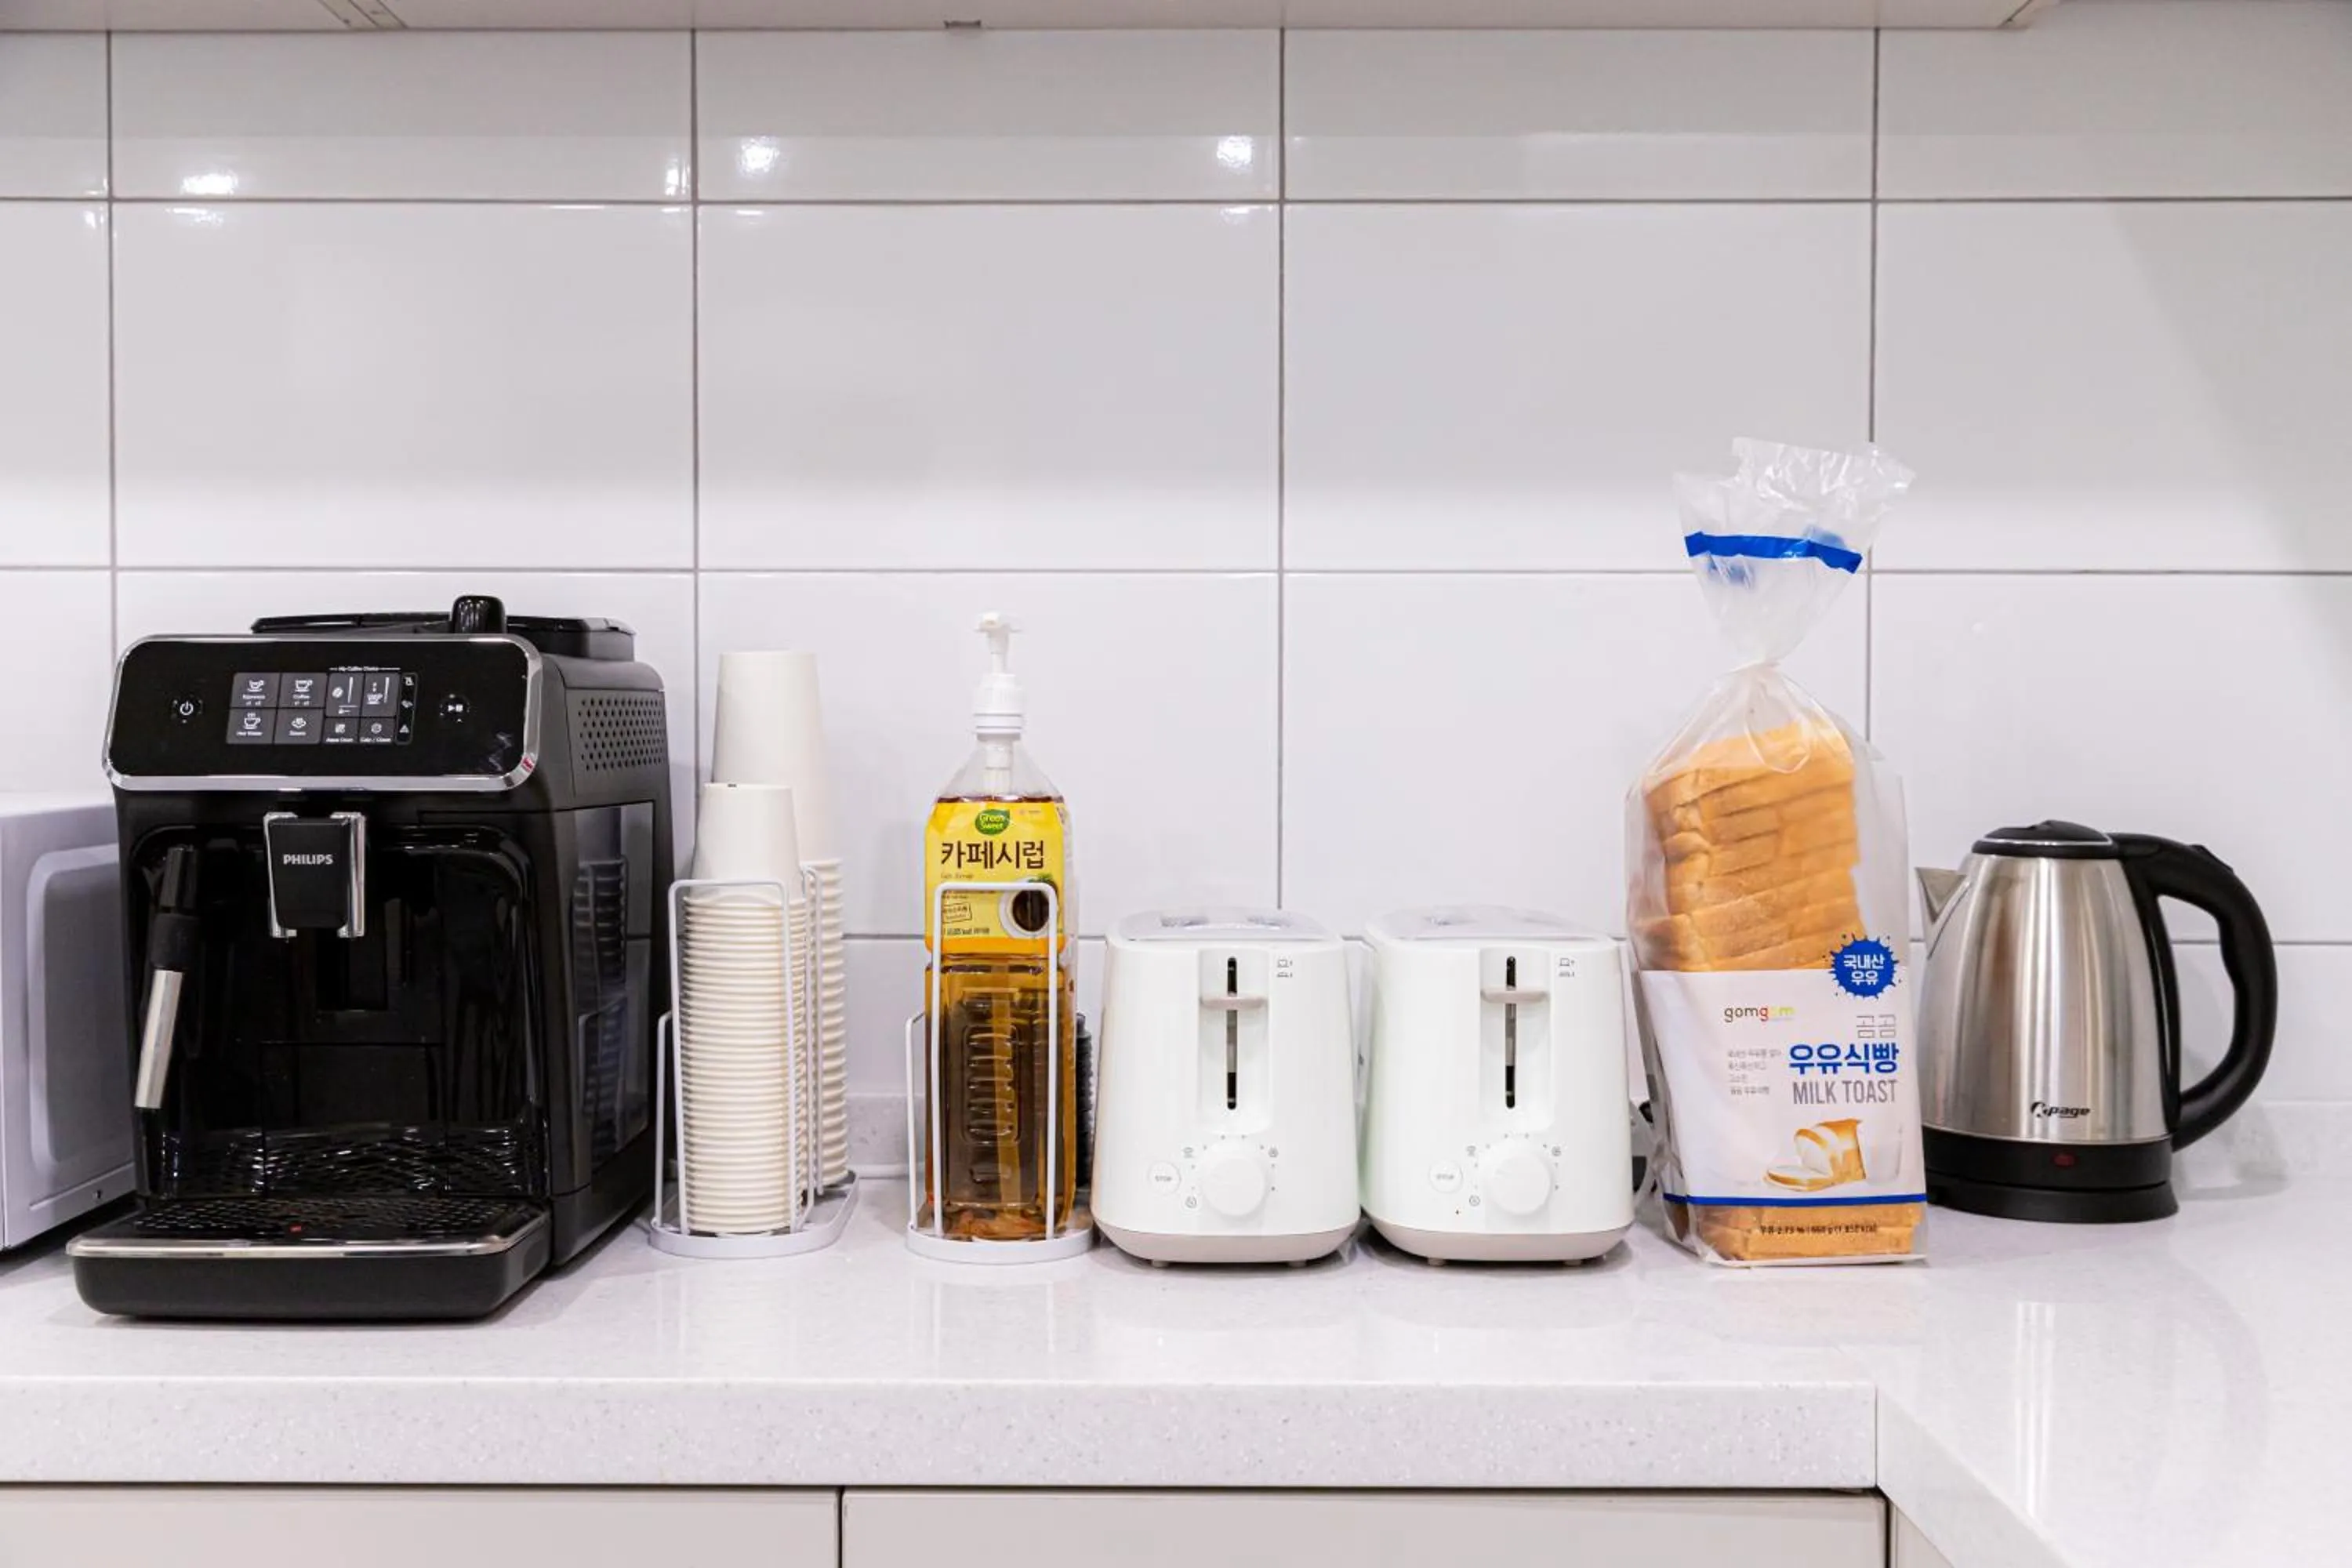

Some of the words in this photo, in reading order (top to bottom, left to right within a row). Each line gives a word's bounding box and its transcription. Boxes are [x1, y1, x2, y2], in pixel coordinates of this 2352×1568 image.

[283, 854, 333, 865] PHILIPS
[942, 840, 1044, 869] 카페시럽
[1843, 953, 1885, 969] 국내산
[1851, 971, 1878, 985] 우유
[1724, 1007, 1795, 1022] gomgm
[1857, 1014, 1896, 1038] 곰곰
[1788, 1042, 1900, 1075] 우유식빵
[1792, 1080, 1837, 1104] MILK
[1842, 1080, 1898, 1103] TOAST
